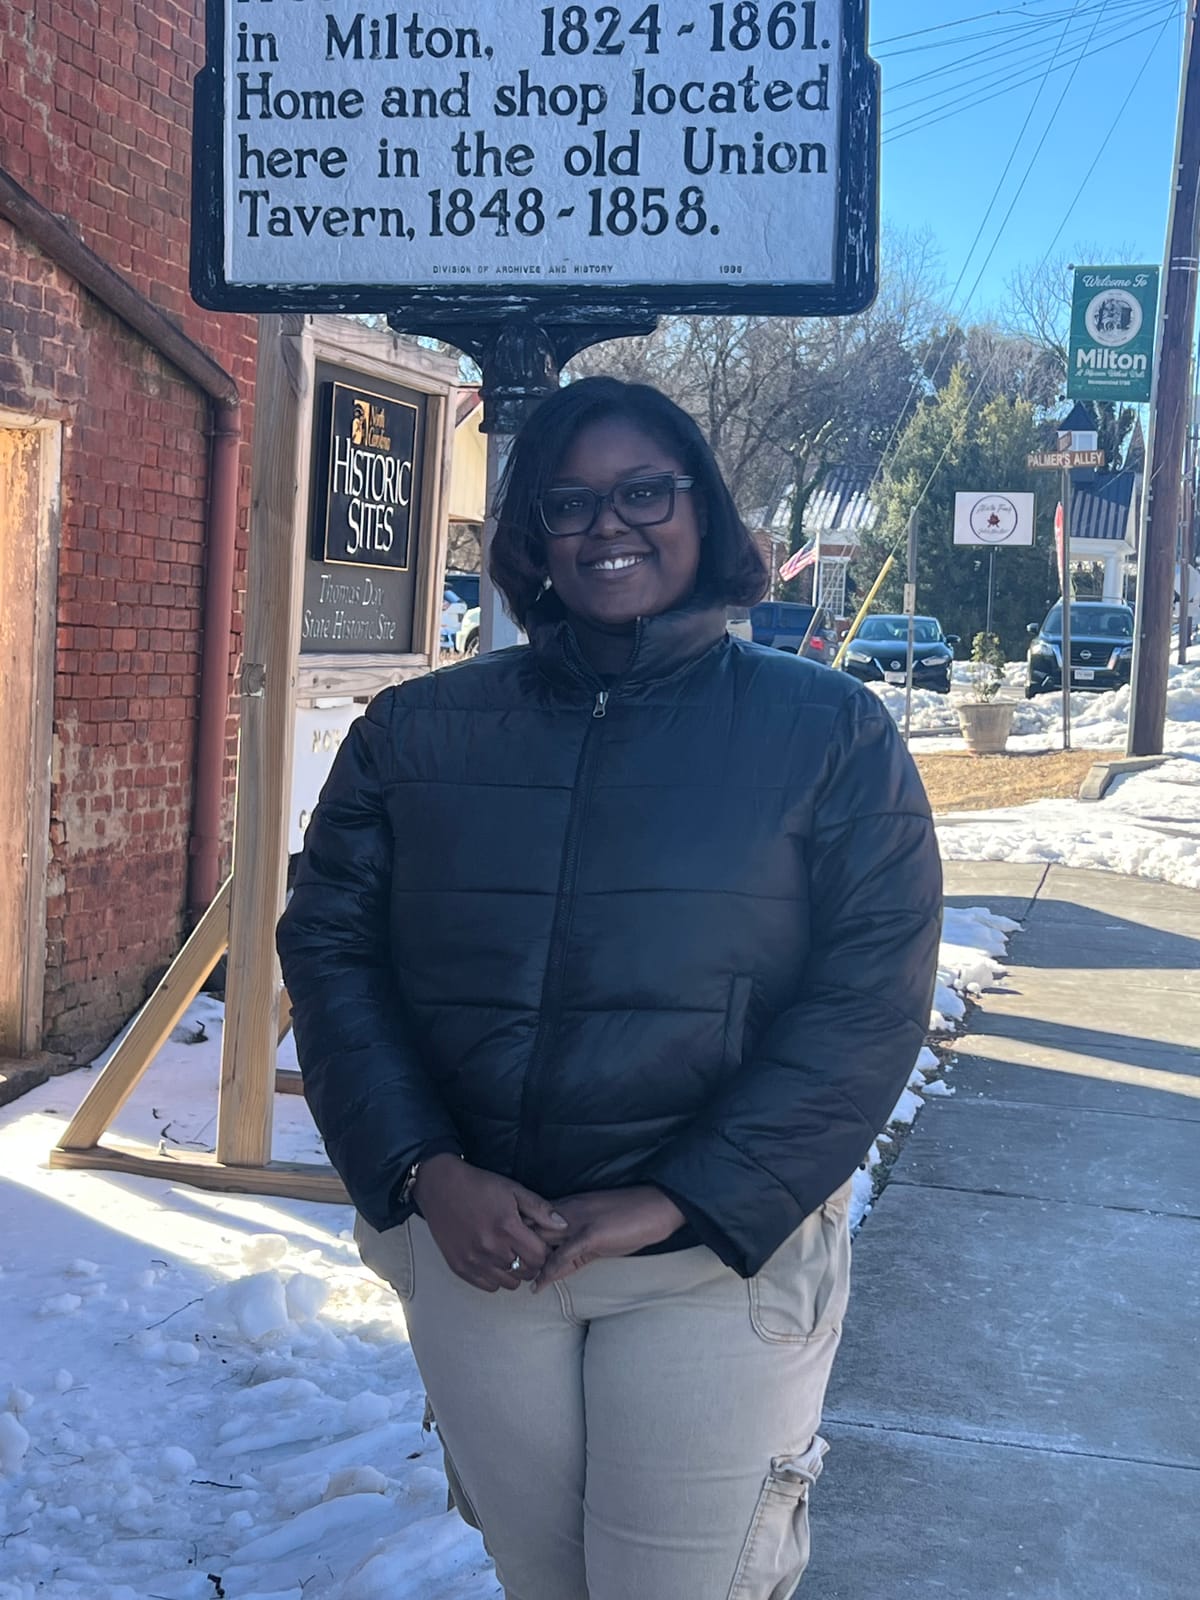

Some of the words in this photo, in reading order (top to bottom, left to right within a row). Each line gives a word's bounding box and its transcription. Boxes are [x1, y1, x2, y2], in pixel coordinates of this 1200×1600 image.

[237, 22, 279, 62] in
[325, 12, 494, 61] Milton,
[237, 72, 364, 120] Home
[381, 71, 471, 118] and
[494, 69, 608, 125] shop
[631, 64, 830, 116] located
[238, 133, 347, 179] here
[378, 138, 420, 178] in
[451, 130, 535, 178] the
[564, 129, 640, 177] old
[683, 126, 828, 175] Union
[239, 189, 416, 242] Tavern,
[432, 265, 471, 274] DIVISION
[477, 265, 489, 274] OF
[495, 265, 541, 274] ARCHIVES
[550, 265, 567, 274] AND
[574, 264, 613, 273] HISTORY
[1082, 275, 1131, 287] Welcome
[1132, 274, 1150, 287] To
[1076, 348, 1147, 370] Milton
[333, 435, 412, 507] HISTORIC
[1027, 452, 1071, 467] PALMER'S
[1073, 451, 1102, 465] ALLEY
[346, 497, 394, 554] SITES
[320, 574, 360, 604] Thomas
[362, 578, 384, 609] Day
[303, 609, 330, 638] State
[332, 611, 374, 640] Historic
[376, 613, 396, 639] Site
